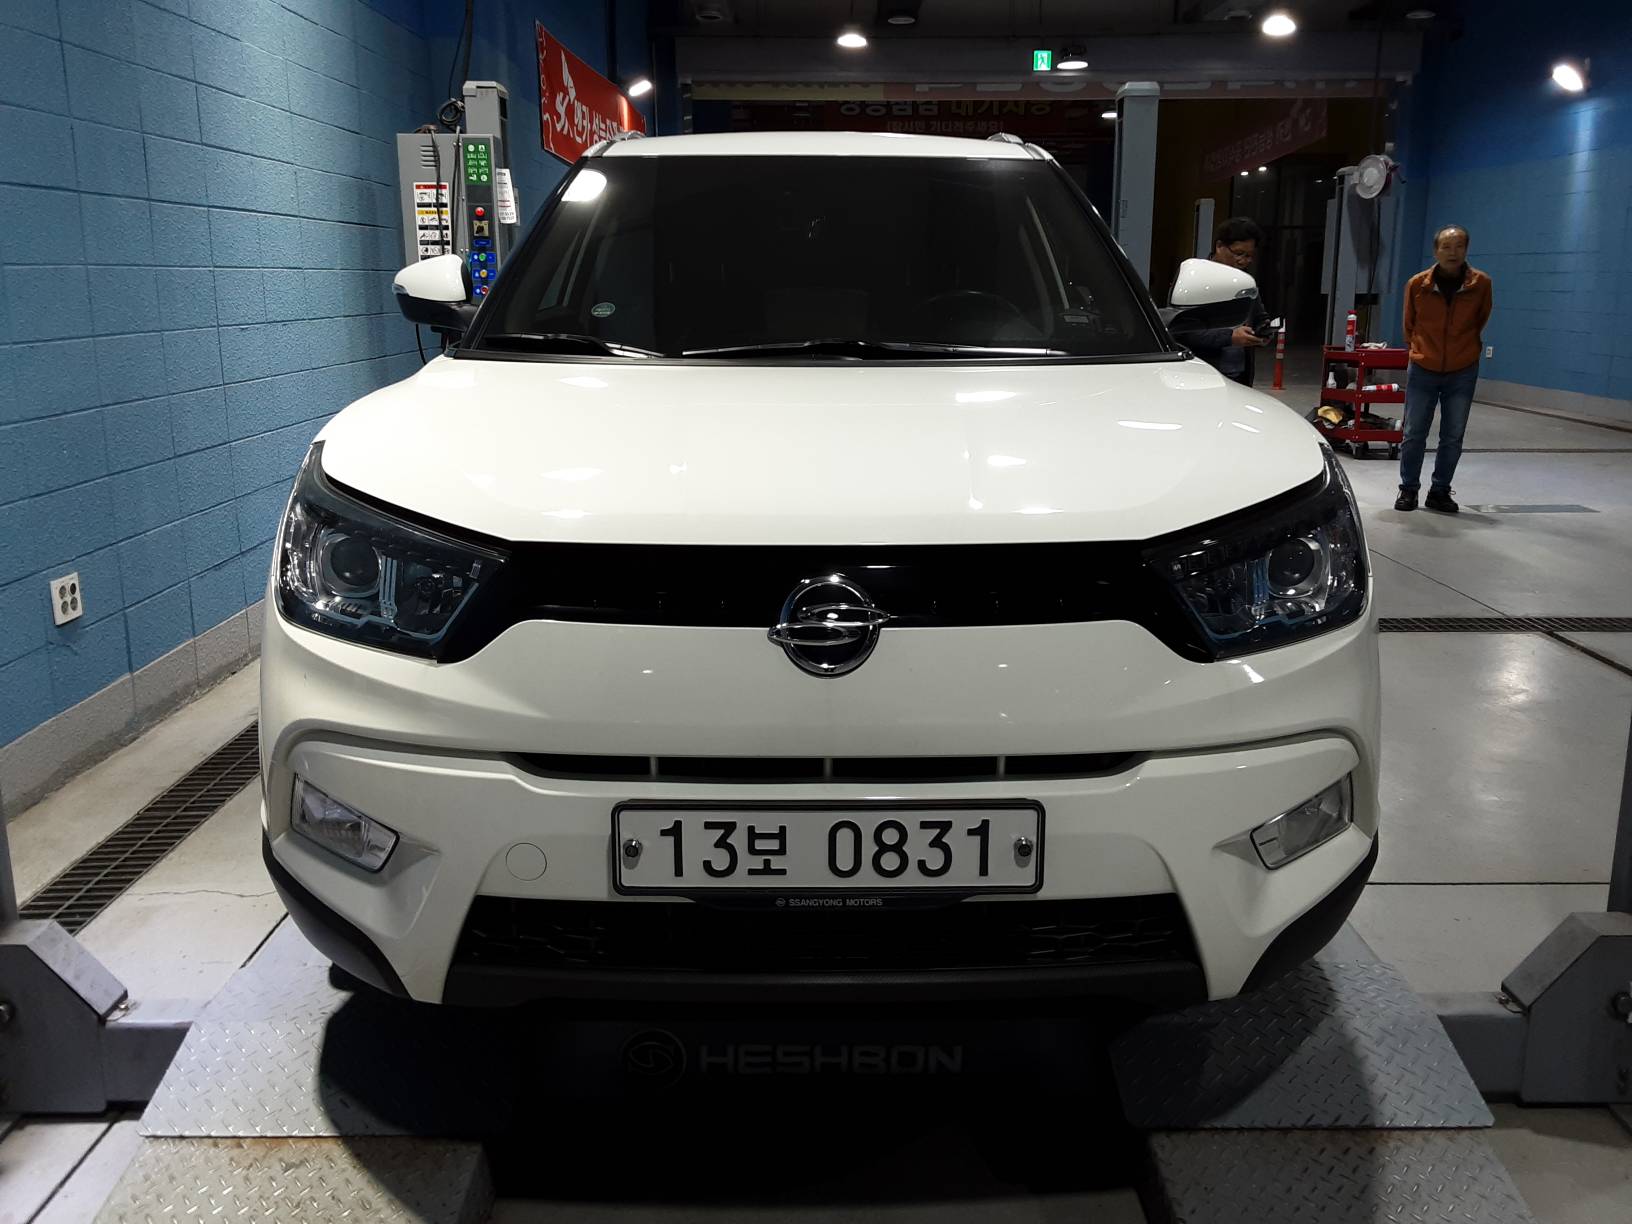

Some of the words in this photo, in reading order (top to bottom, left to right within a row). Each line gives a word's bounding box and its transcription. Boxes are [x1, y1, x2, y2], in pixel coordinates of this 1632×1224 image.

[659, 819, 788, 878] 13보
[827, 819, 991, 878] 0831
[788, 898, 843, 907] SSANGYONG
[846, 898, 883, 907] MOTORS
[699, 1043, 965, 1075] HESHBON
